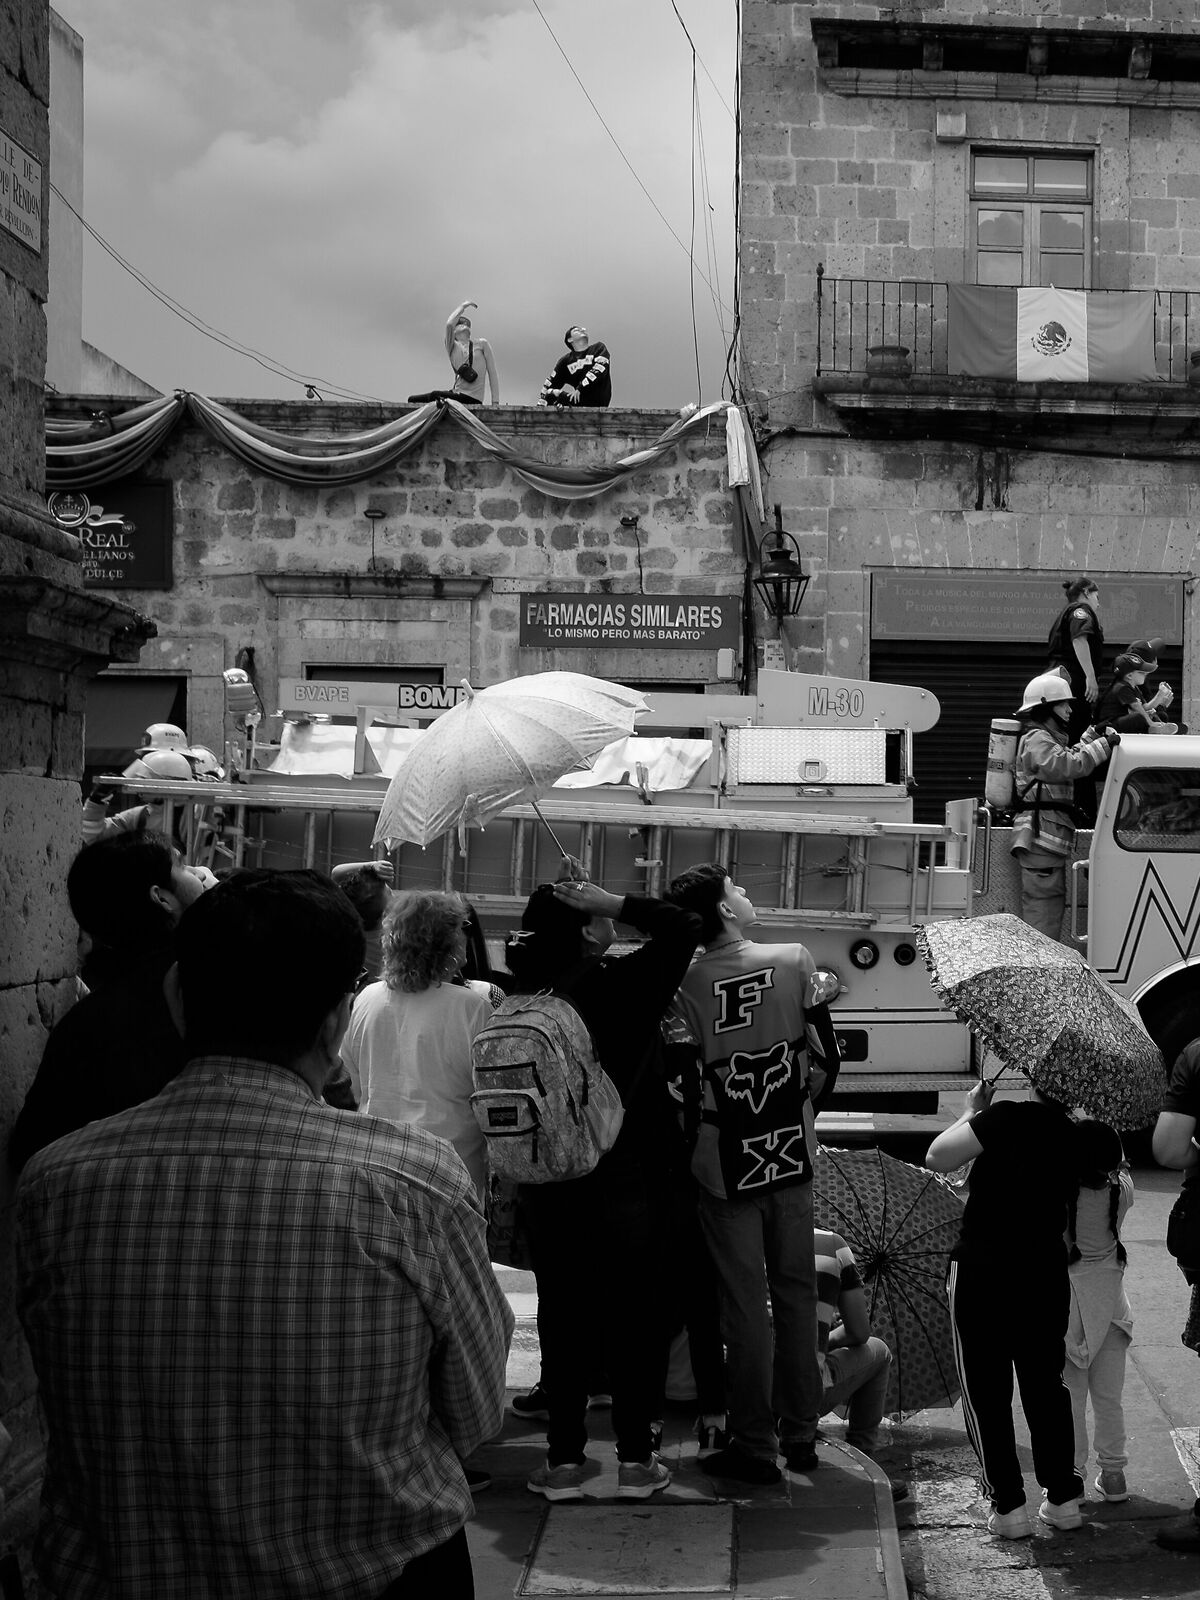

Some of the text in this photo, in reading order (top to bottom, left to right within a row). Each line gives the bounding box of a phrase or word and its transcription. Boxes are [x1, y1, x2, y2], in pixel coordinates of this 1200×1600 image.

[77, 528, 130, 547] REAL
[83, 551, 135, 560] ELIANOS
[893, 584, 920, 597] TODA
[922, 589, 934, 597] LA
[970, 590, 986, 598] DEL
[988, 591, 1020, 599] MUNDO
[1043, 592, 1067, 600] ALCA
[527, 603, 723, 628] FARMACIAS SIMILARES
[905, 600, 1061, 615] PEDIDOS ESPECIALES DE IMPORTAC
[565, 628, 599, 638] MISMO
[601, 629, 631, 639] PERO
[633, 630, 653, 639] MAS
[294, 684, 350, 702] BVAPE
[808, 686, 865, 718] M-30
[713, 967, 775, 1035] F
